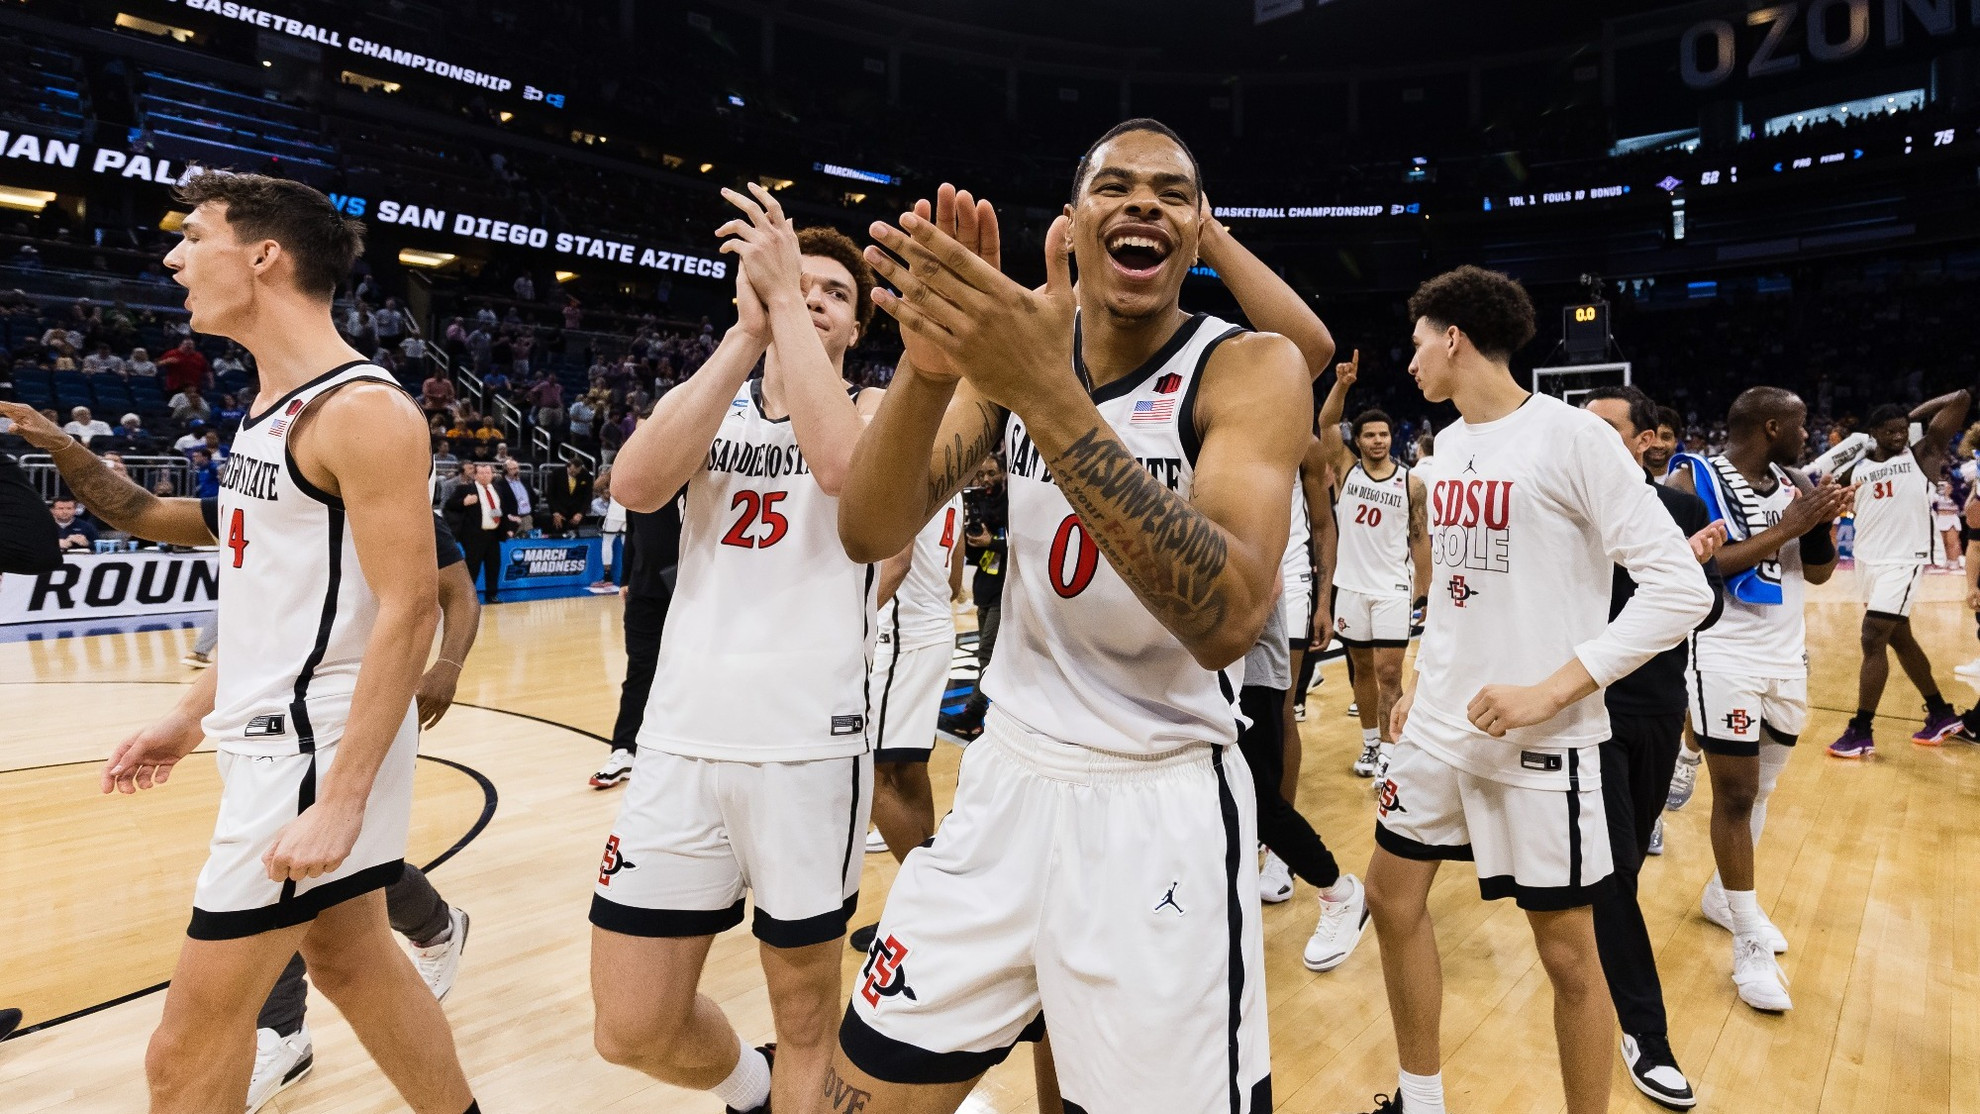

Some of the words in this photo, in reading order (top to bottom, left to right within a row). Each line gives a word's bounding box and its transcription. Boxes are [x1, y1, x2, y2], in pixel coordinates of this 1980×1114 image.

[185, 0, 342, 47] BASKETBALL
[348, 36, 512, 92] CHAMPIONSHIP
[1680, 0, 1980, 88] OZON
[1934, 129, 1955, 146] 75
[0, 129, 80, 168] AN
[329, 193, 367, 217] VS
[377, 200, 446, 231] SAN
[453, 213, 549, 248] DIEGO
[555, 232, 636, 264] STATE
[639, 248, 727, 279] AZTECS
[1214, 206, 1286, 218] BASKETBALL
[1288, 205, 1383, 218] CHAMPIONSHIP
[1509, 196, 1525, 207] TOL
[1543, 191, 1571, 203] FOULS
[1590, 186, 1622, 198] BONUS
[1575, 306, 1596, 322] 0.0
[708, 438, 740, 473] SAN
[1009, 423, 1041, 480] SAN
[1889, 462, 1911, 476] STATE
[240, 456, 280, 501] STATE
[1347, 483, 1359, 495] SAN
[1359, 486, 1380, 502] DIEGO
[1380, 492, 1402, 508] STATE
[1873, 480, 1894, 499] 31
[720, 489, 789, 549] 25
[1069, 485, 1105, 518] your
[1355, 504, 1382, 527] 20
[1433, 479, 1514, 531] SDSU
[220, 504, 249, 568] 4
[523, 549, 568, 562] MARCH
[1048, 513, 1099, 598] 0
[1433, 524, 1510, 574] SOLE
[27, 560, 219, 611] ROUN
[529, 559, 585, 573] MADNESS
[824, 1064, 872, 1114] OVE
